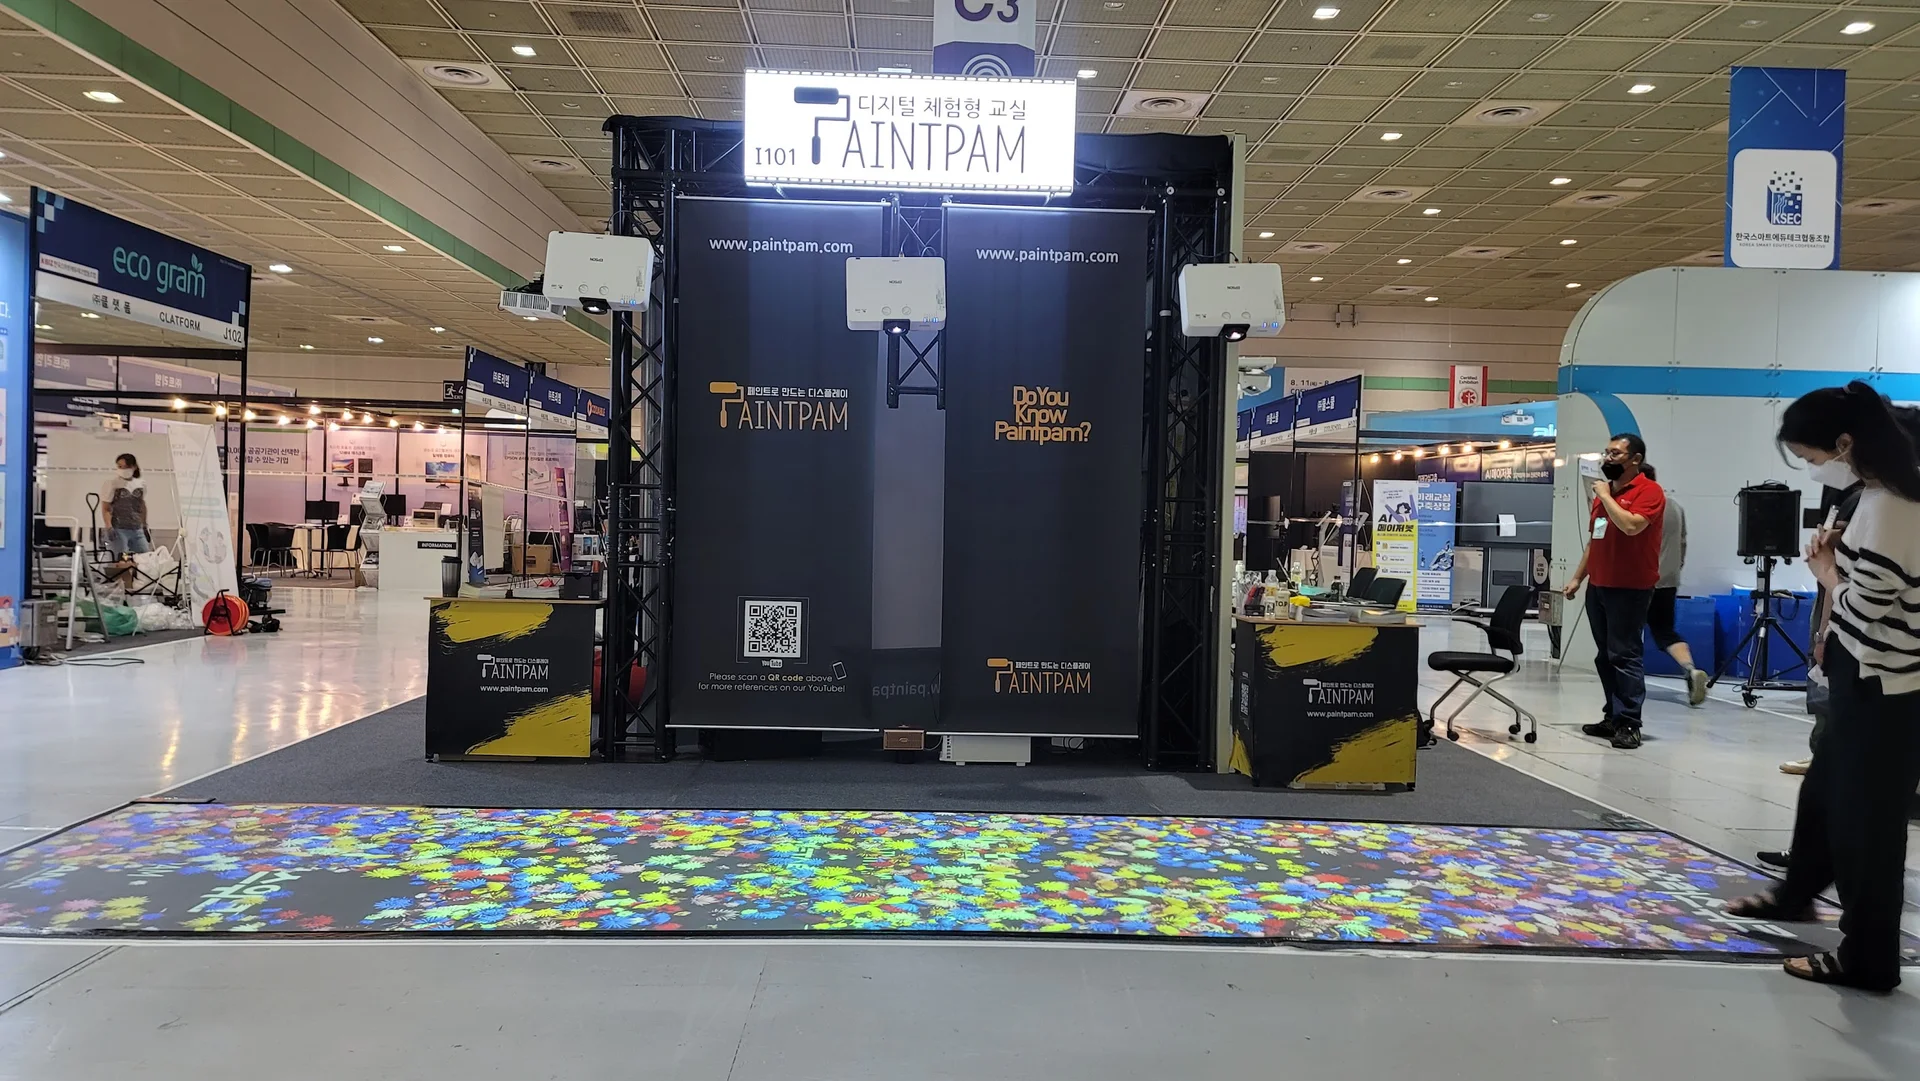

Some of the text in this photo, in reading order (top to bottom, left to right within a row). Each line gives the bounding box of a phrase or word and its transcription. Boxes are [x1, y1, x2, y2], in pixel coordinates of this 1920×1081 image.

[858, 94, 1027, 121] 디지털 체험형 교실
[755, 147, 796, 166] I101
[1773, 212, 1801, 224] KSEC
[1735, 232, 1830, 243] 한국스마트에듀테크협동조합
[709, 237, 853, 254] www.paintpam.com
[976, 247, 1119, 264] www.paintpam.com
[113, 246, 150, 281] eco
[156, 260, 206, 299] gram
[223, 327, 242, 344] J102
[747, 386, 848, 399] 페인트로 만드는 디스플레이
[1015, 403, 1067, 424] Know
[995, 420, 1092, 446] Paintpam?
[1378, 513, 1392, 523] AI
[709, 672, 736, 681] Please
[738, 674, 758, 682] scan
[768, 673, 780, 682] QR
[782, 673, 804, 683] code
[805, 674, 833, 683] above
[480, 685, 549, 693] www.paintpam.com
[698, 682, 709, 690] for
[734, 682, 778, 692] references
[1306, 710, 1374, 718] www.paintpam.com
